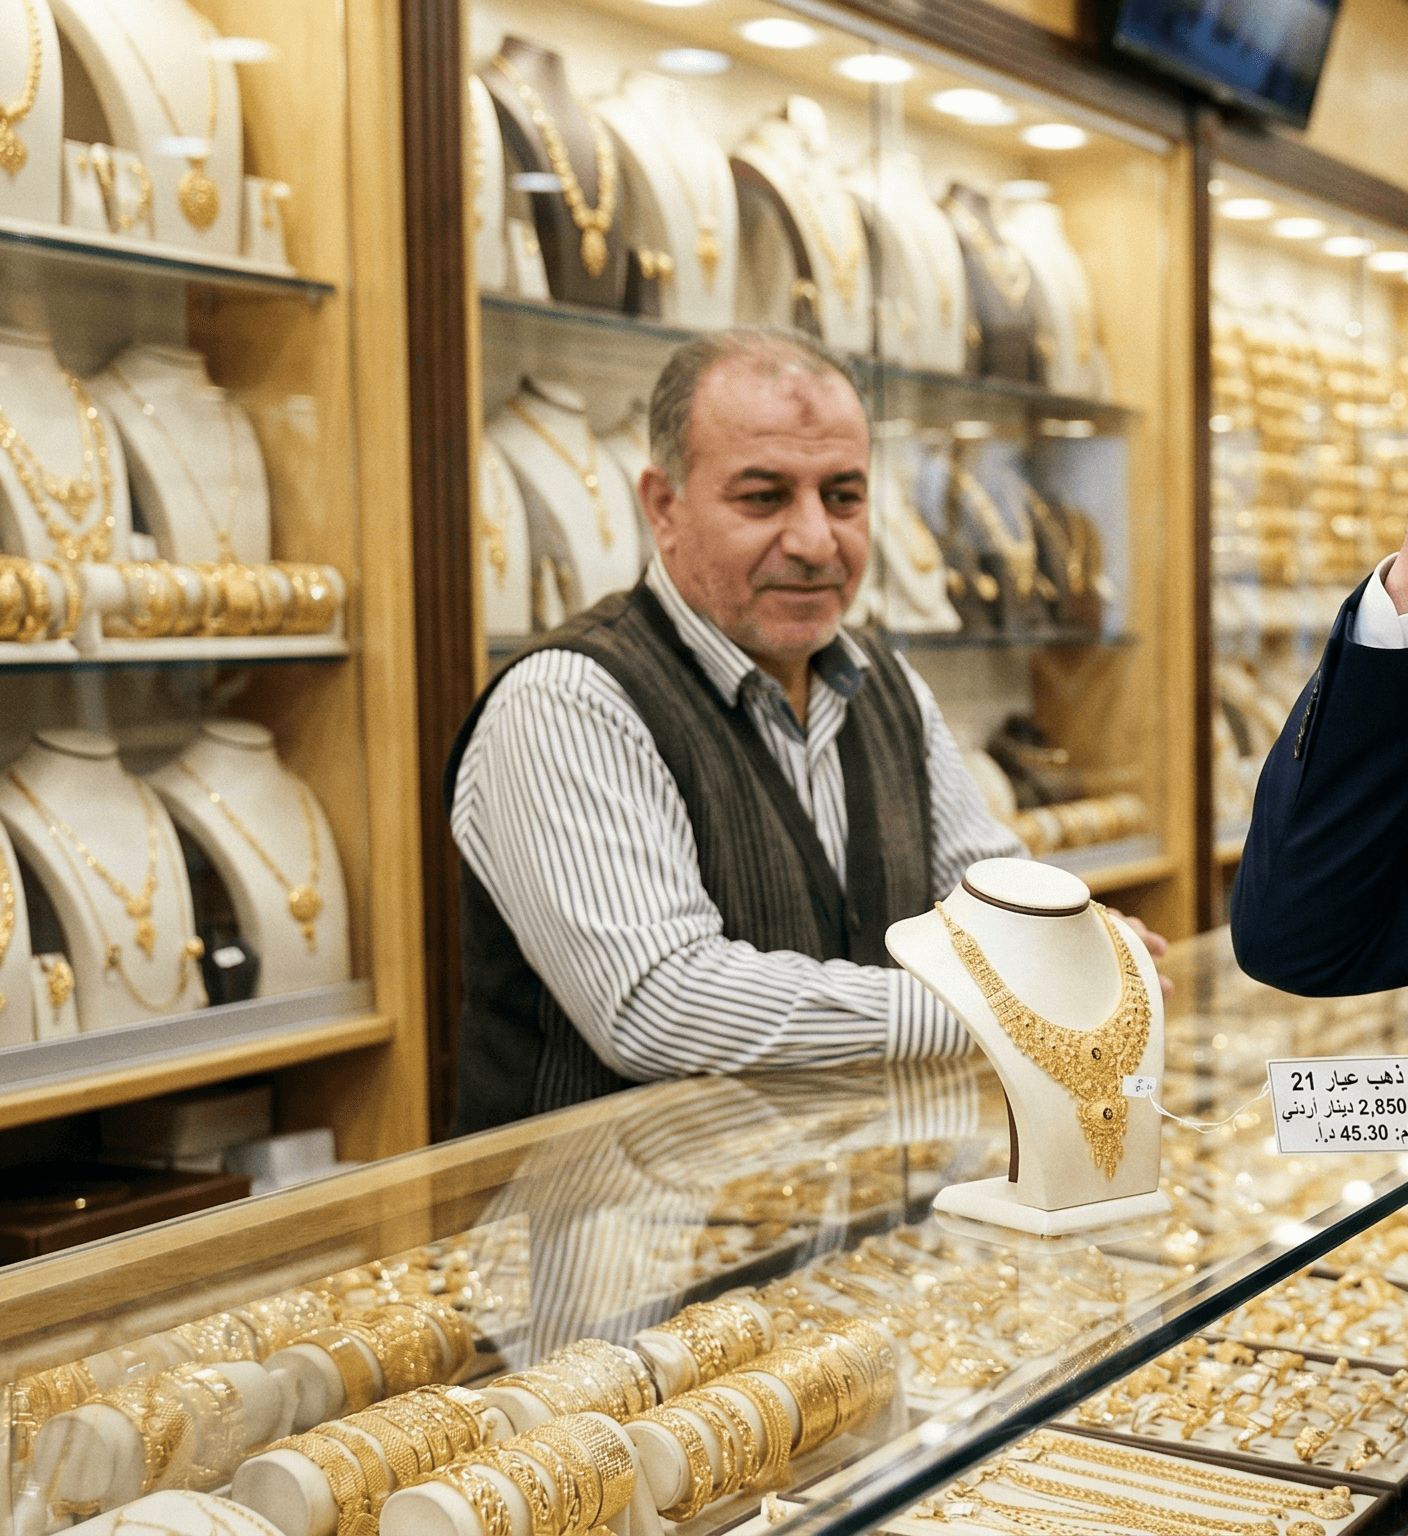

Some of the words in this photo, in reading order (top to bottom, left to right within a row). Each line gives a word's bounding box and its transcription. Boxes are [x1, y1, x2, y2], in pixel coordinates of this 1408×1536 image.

[1290, 1071, 1315, 1091] 21
[1325, 1070, 1359, 1092] عيار
[1366, 1064, 1405, 1091] ذهب
[1282, 1097, 1318, 1123] أردني
[1323, 1099, 1354, 1118] دينار
[1358, 1098, 1407, 1118] 2,850
[1340, 1124, 1389, 1142] 45.30
